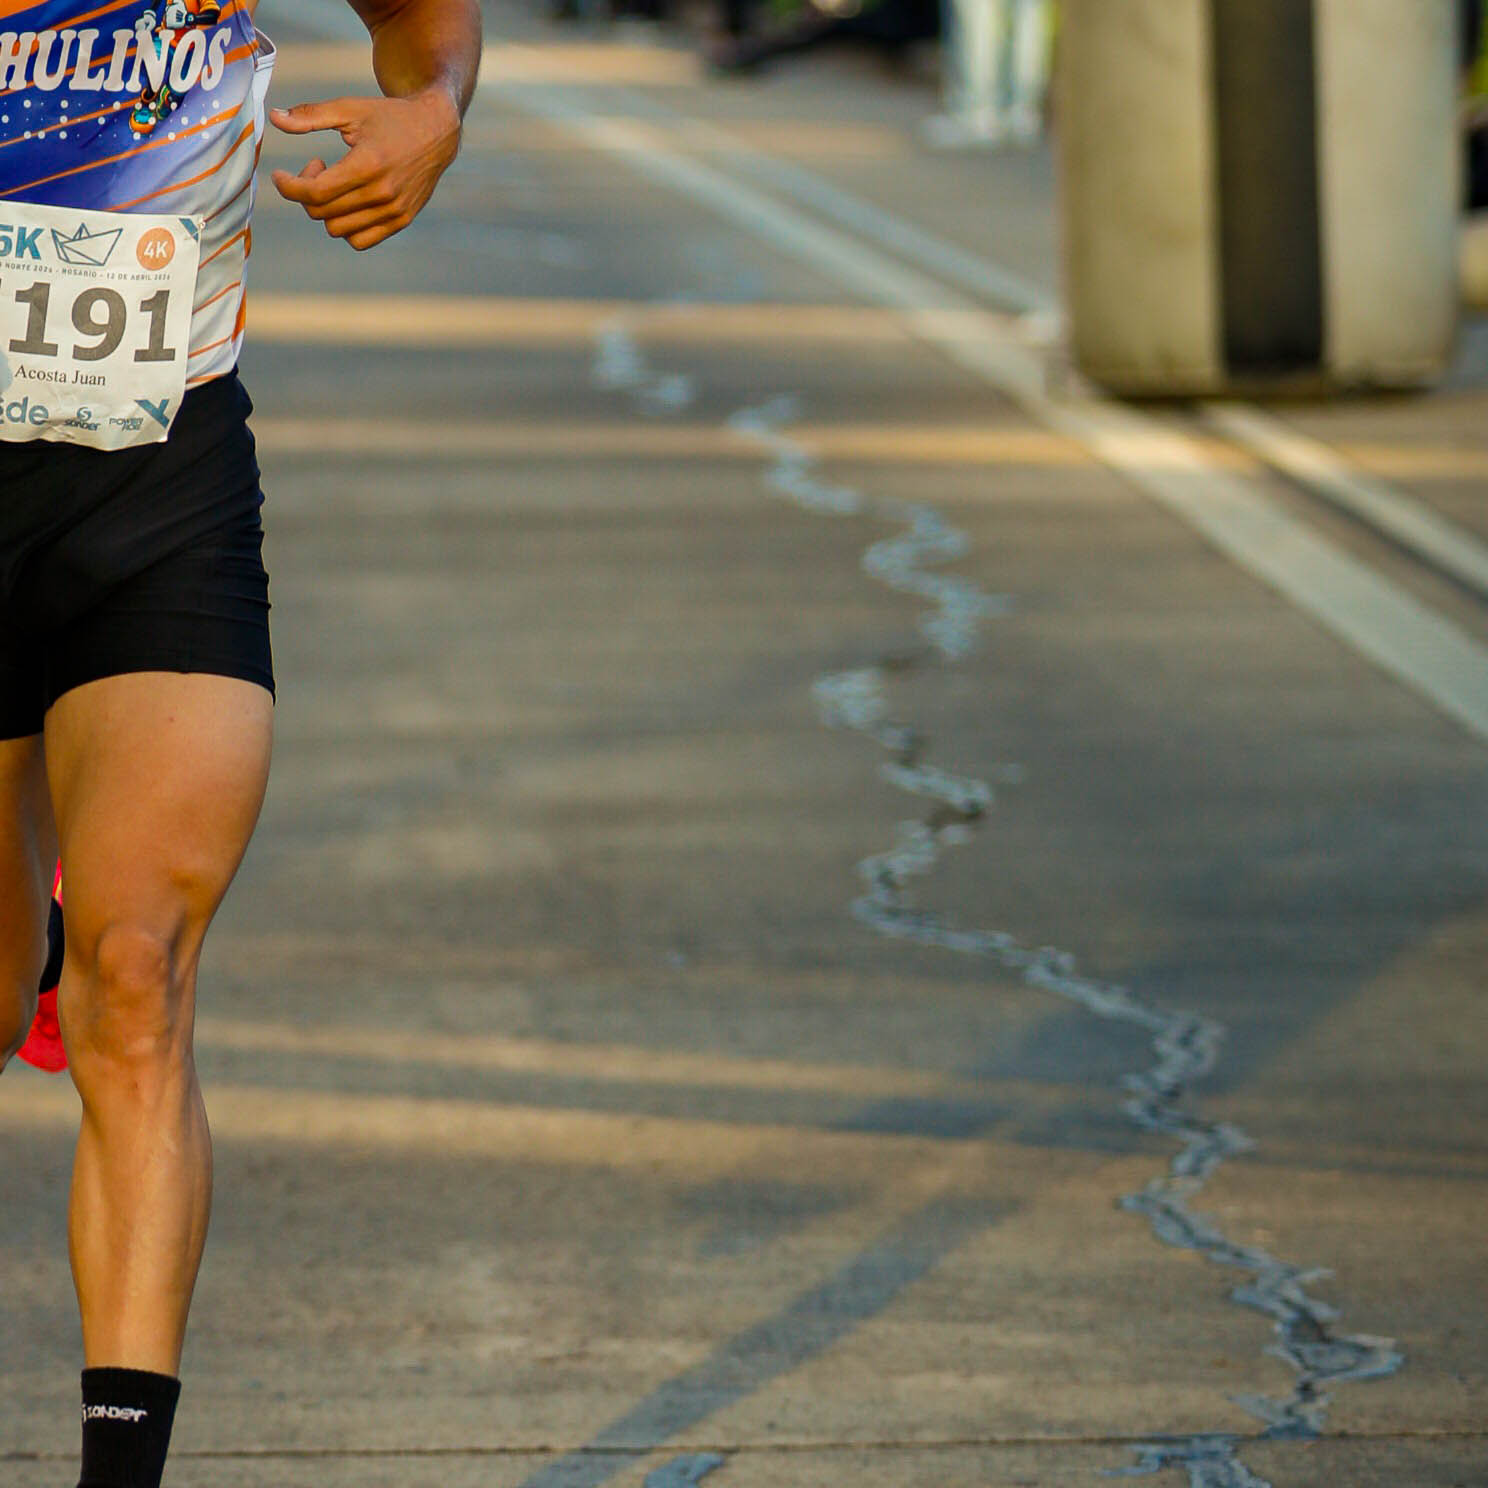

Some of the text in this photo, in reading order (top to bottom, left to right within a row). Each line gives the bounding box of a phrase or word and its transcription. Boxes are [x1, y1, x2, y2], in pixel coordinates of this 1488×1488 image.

[143, 240, 169, 259] 4K
[5, 262, 31, 272] NORTE
[14, 365, 106, 386] Acosta Juan
